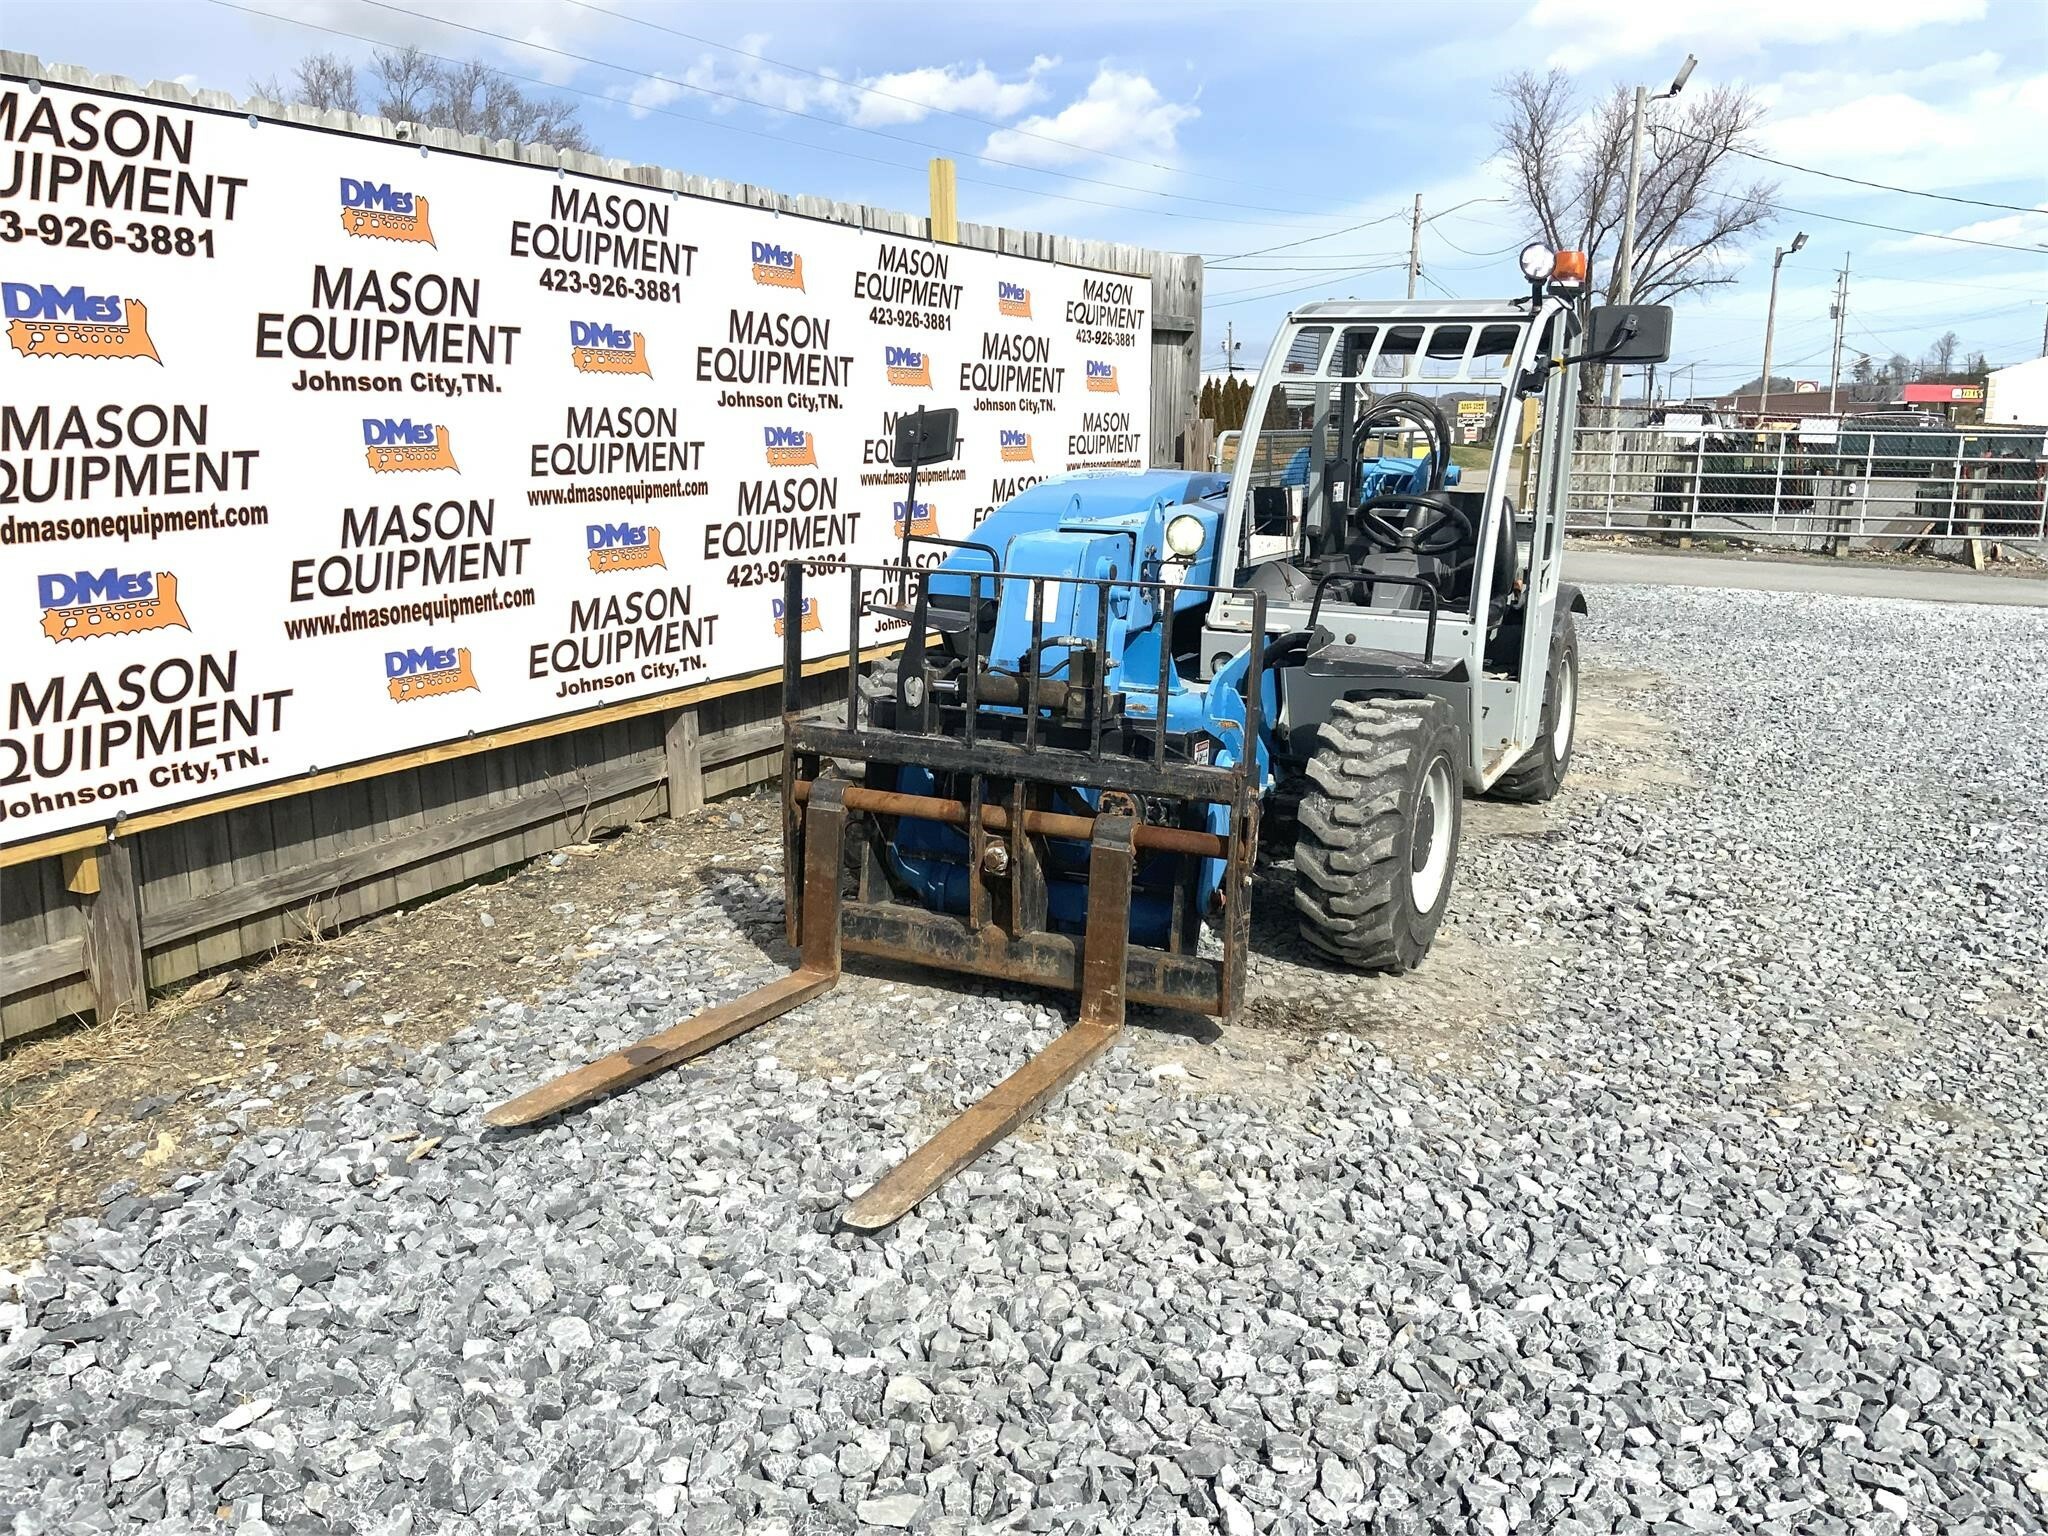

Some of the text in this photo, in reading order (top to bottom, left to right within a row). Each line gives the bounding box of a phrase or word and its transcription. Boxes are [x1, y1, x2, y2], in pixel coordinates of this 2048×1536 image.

[551, 185, 668, 236] MASON
[511, 221, 698, 276] EQUIPMENT
[878, 244, 948, 279] MASON
[313, 265, 479, 318] MASON
[540, 268, 680, 303] 423-926-3881
[855, 272, 963, 309] EQUIPMENT
[1082, 279, 1133, 305] MASON
[730, 310, 830, 350] MASON
[870, 307, 950, 331] 423-926-3881
[1066, 301, 1144, 329] EQUIPMENT
[256, 313, 521, 364] EQUIPMENT
[982, 332, 1050, 363] MASON
[1076, 329, 1134, 346] 423-926-3881
[292, 370, 402, 391] Johnson
[697, 347, 853, 387] EQUIPMENT
[960, 363, 1064, 393] EQUIPMENT
[718, 391, 782, 407] Johnson
[974, 398, 1016, 411] Johnson
[2, 405, 207, 451] MASON
[567, 407, 676, 438] MASON
[1083, 413, 1129, 432] MASON
[532, 442, 704, 476] EQUIPMENT
[1068, 434, 1141, 455] EQUIPMENT
[527, 479, 708, 506] www.dmasonequipment.com
[738, 478, 837, 516] MASON
[1, 503, 268, 544] dmasonequipment.com
[342, 499, 494, 549] MASON
[704, 513, 860, 560] EQUIPMENT
[291, 538, 531, 602] EQUIPMENT
[284, 588, 535, 640] www.dmasonequipment.com
[570, 585, 690, 633] MASON
[530, 615, 718, 679] EQUIPMENT
[9, 650, 237, 730] MASON
[556, 672, 635, 697] Johnson
